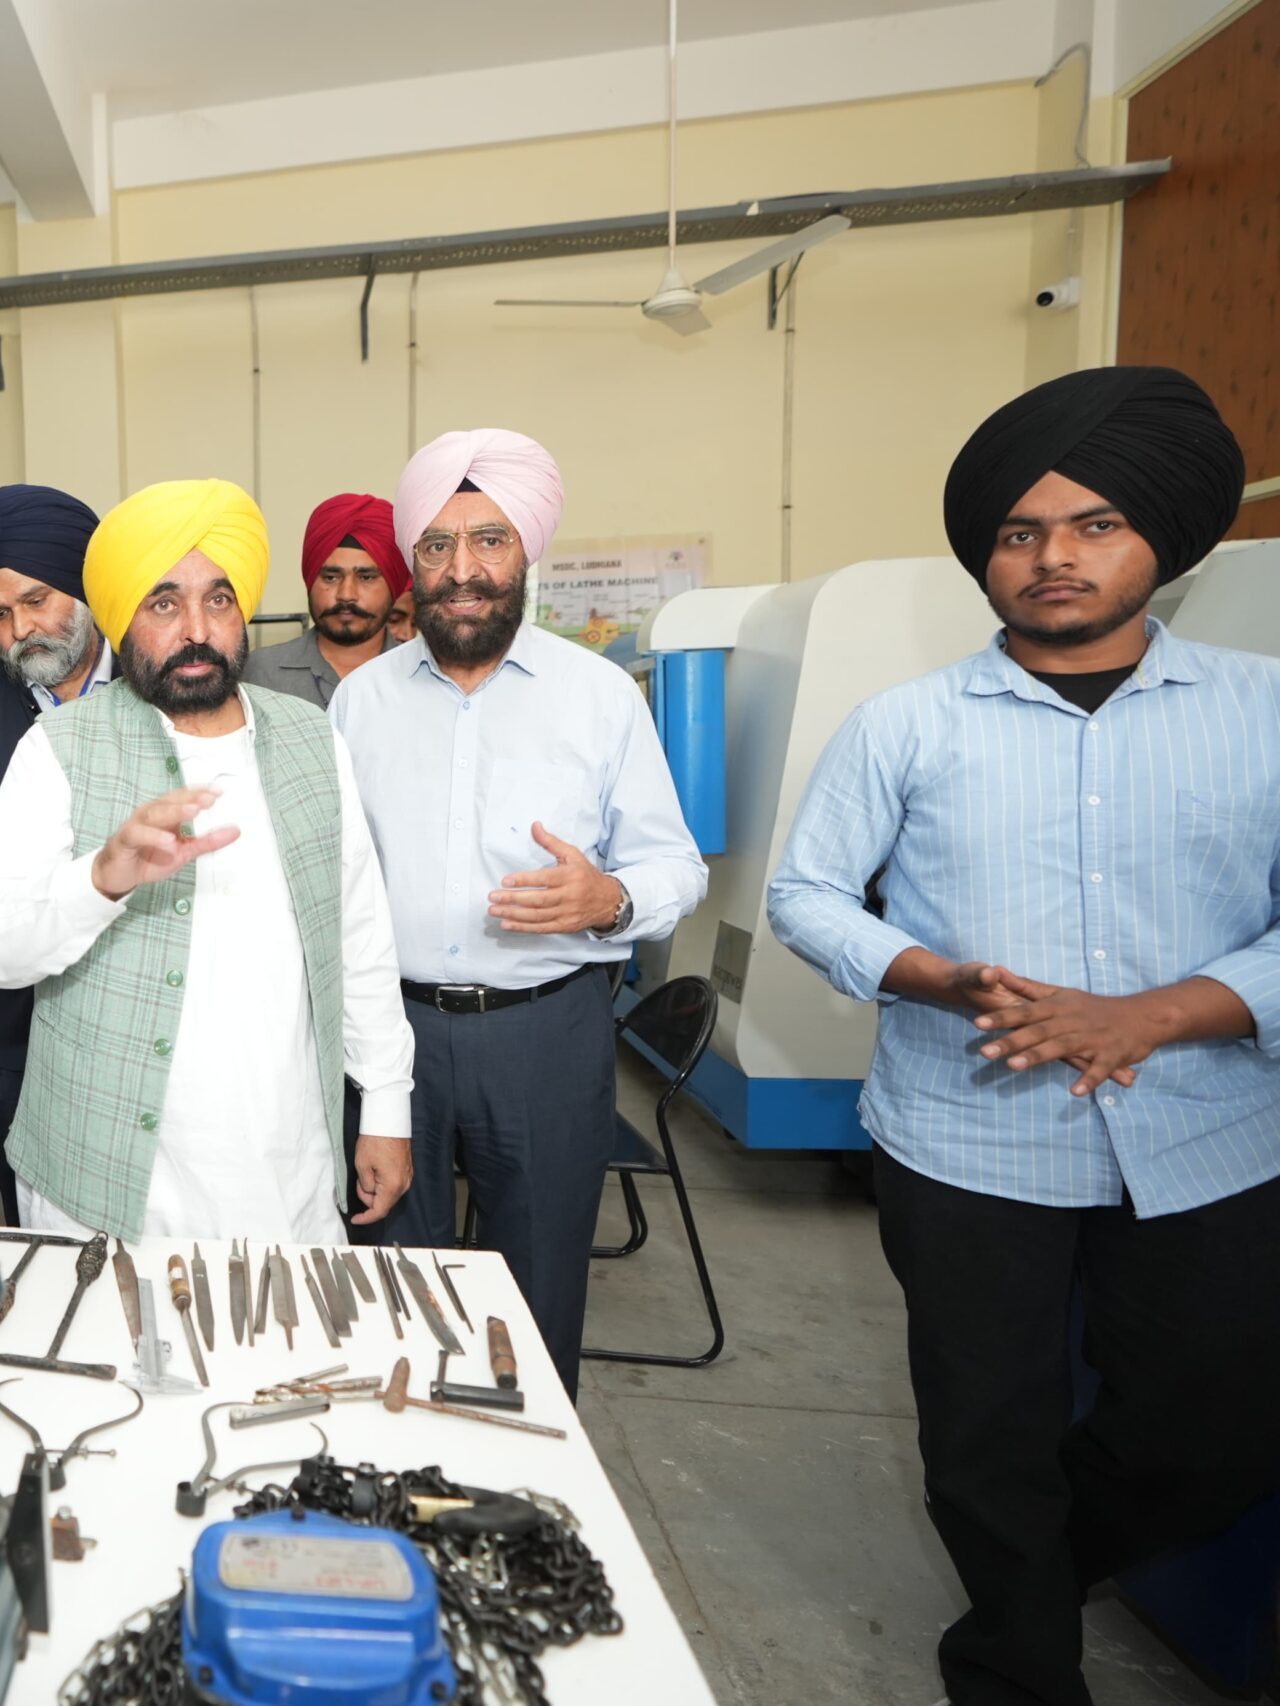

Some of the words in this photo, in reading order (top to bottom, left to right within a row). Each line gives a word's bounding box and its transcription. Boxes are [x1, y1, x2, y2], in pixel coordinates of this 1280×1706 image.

[581, 560, 622, 570] LUDHIANA
[553, 581, 566, 589] OF
[570, 579, 603, 588] LATHE
